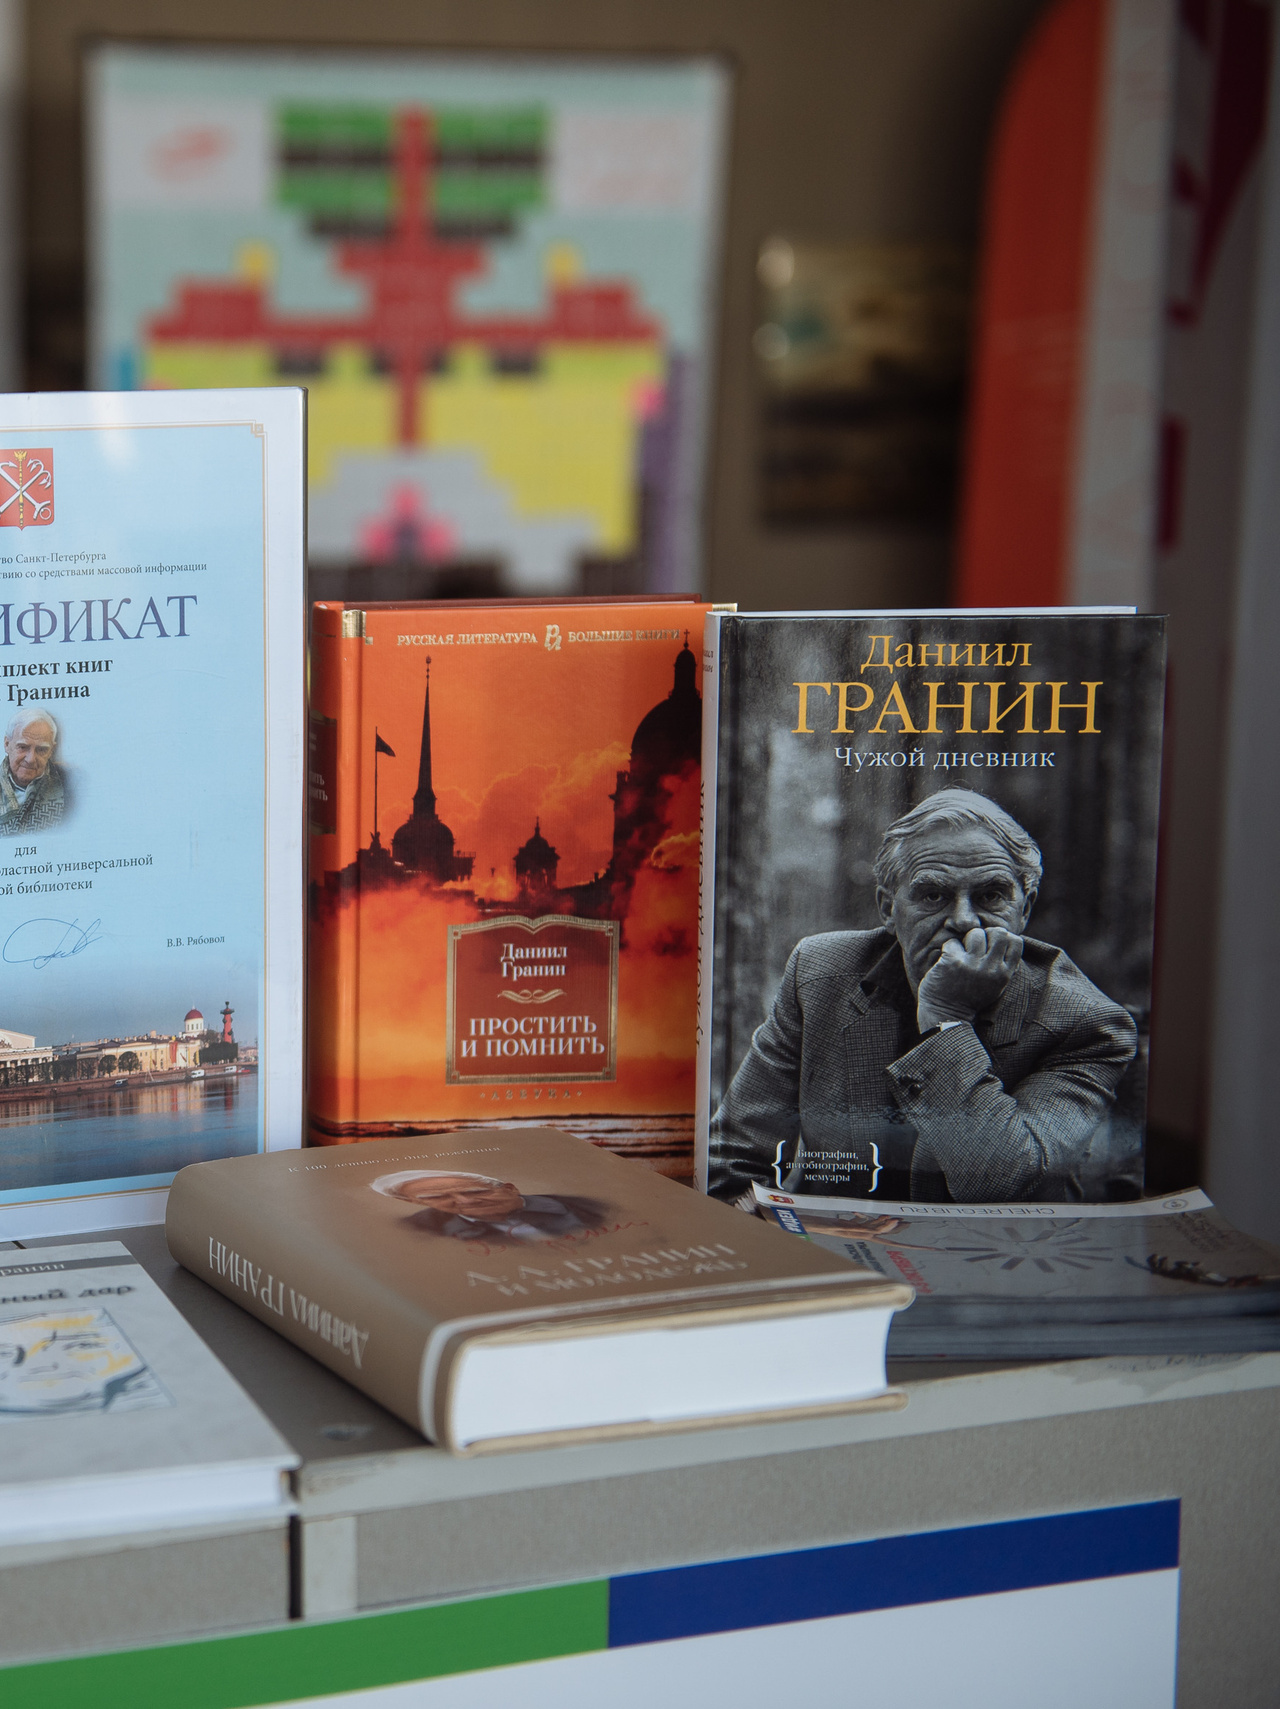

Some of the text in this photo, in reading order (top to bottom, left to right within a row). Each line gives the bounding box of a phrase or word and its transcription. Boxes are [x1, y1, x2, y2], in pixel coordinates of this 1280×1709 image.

[15, 551, 107, 566] Санкт-Петербурга
[25, 570, 37, 579] со
[38, 567, 95, 580] средствами
[97, 563, 143, 576] массовой
[144, 561, 208, 576] информации
[396, 634, 455, 647] РУССКАЯ
[456, 632, 538, 646] ЛИТЕРАТУРА
[568, 629, 634, 643] БОЛЬШИЕ
[634, 628, 681, 642] КНИГИ
[860, 634, 1033, 674] Даниил
[65, 657, 114, 676] книг
[7, 684, 91, 707] Гранина
[790, 681, 1105, 735] ГРАНИН
[833, 746, 1056, 773] Чужой дневник
[14, 844, 38, 859] для
[56, 854, 154, 875] универсальной
[17, 877, 93, 897] библиотеки
[166, 933, 226, 949] В.В. Рябовол
[500, 943, 568, 963] Даниил
[501, 961, 566, 982] Гранин
[469, 1015, 597, 1037] ПРОСТИТЬ
[460, 1037, 606, 1058] И ПОМНИТЬ
[797, 1149, 859, 1161] Биографии,
[785, 1161, 870, 1173] автобиографии,
[804, 1174, 851, 1184] мемуары
[563, 1243, 737, 1273] ГРАНИН
[77, 1284, 135, 1299] дар
[208, 1236, 370, 1370] Даниил ГРАНИН
